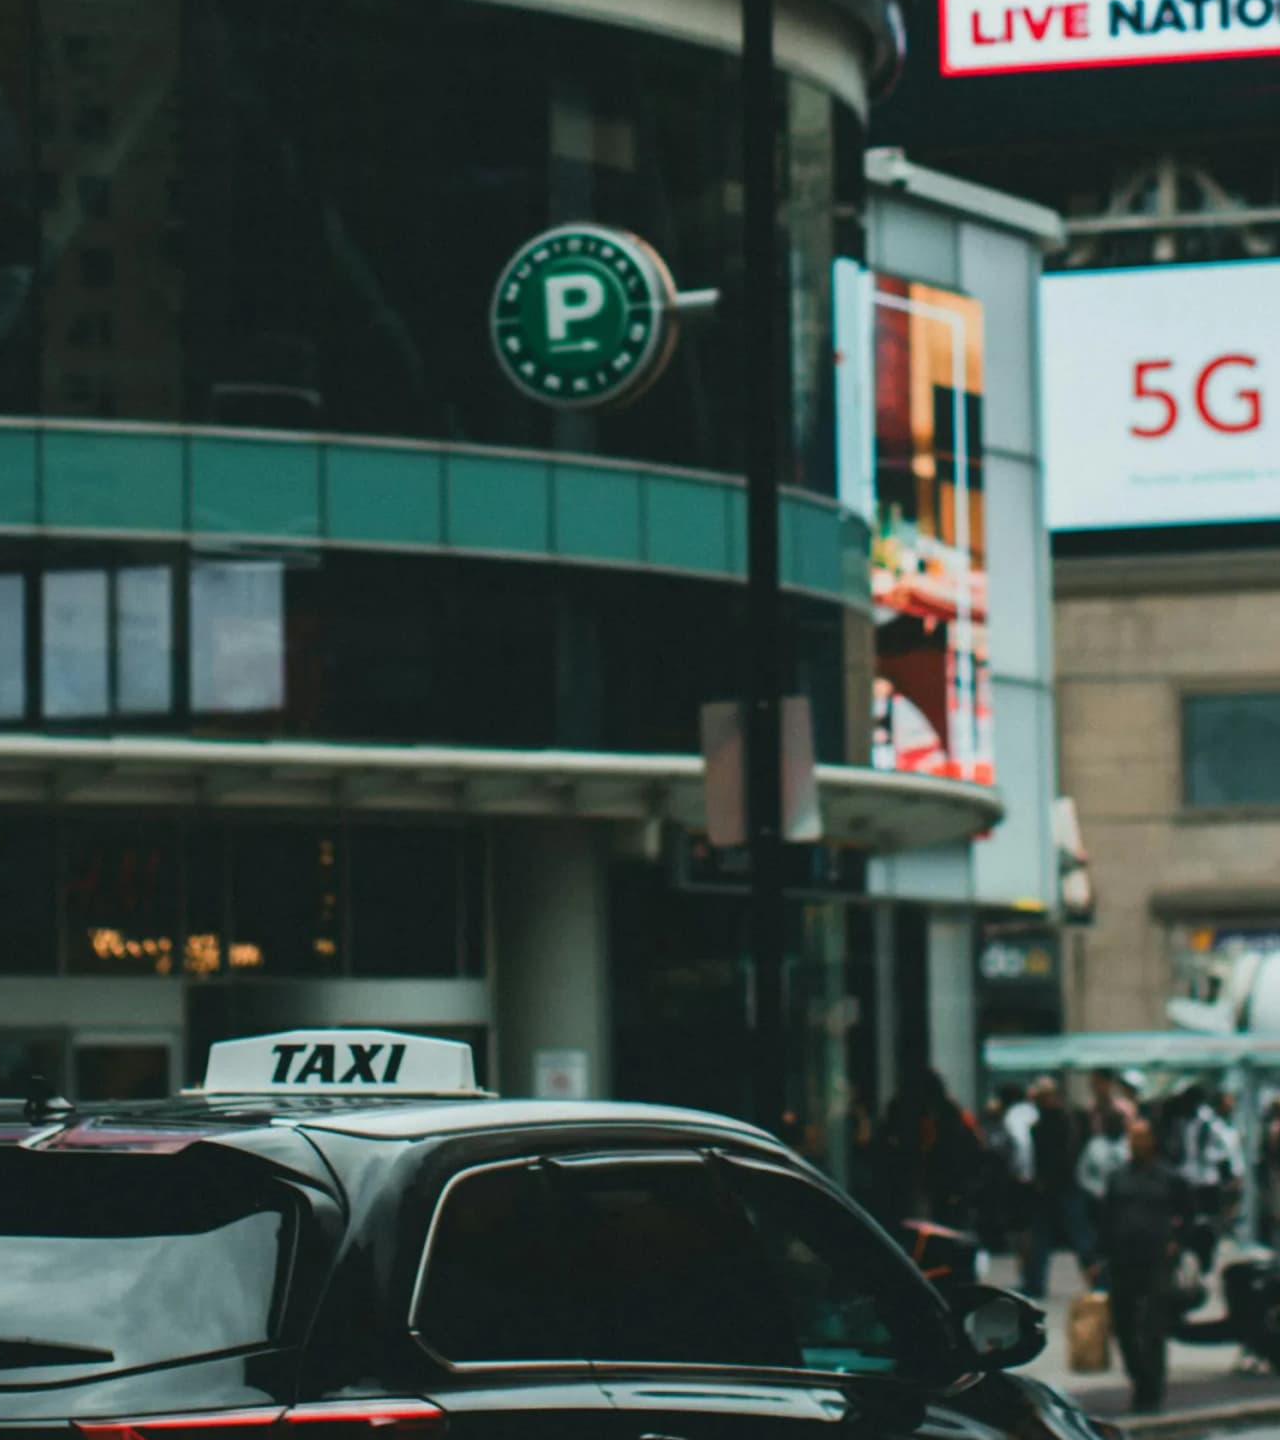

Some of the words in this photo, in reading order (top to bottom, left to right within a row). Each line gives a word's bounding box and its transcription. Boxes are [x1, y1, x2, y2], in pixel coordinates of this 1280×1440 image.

[969, 0, 1090, 48] LIVE
[543, 272, 605, 342] P
[1129, 351, 1264, 440] 5G
[271, 1043, 408, 1084] TAXI
